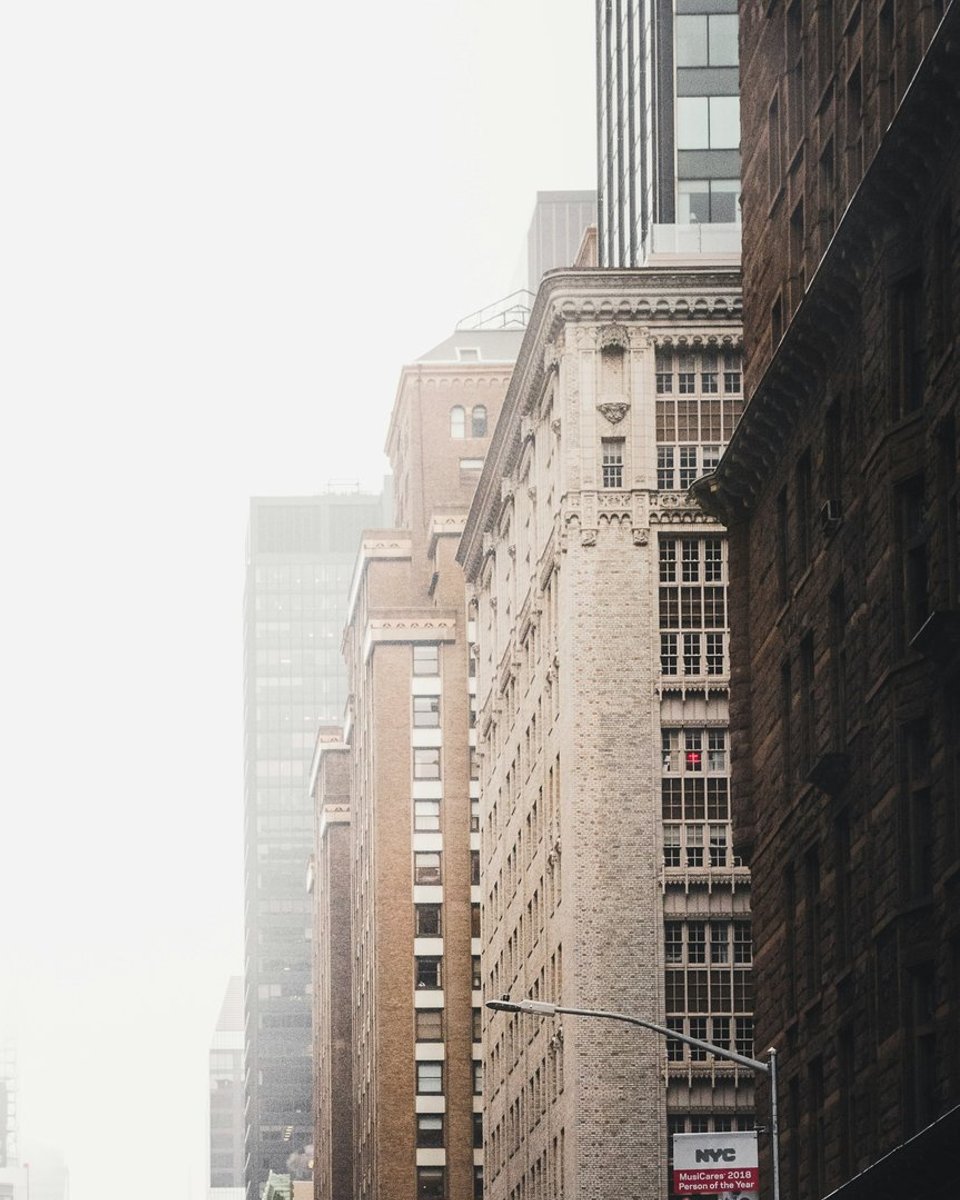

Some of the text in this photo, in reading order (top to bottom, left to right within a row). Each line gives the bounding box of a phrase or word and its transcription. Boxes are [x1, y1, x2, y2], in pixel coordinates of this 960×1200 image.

[695, 1148, 736, 1163] NYC
[679, 1171, 752, 1181] MusiCares 2018
[679, 1183, 708, 1191] Person
[720, 1181, 735, 1189] the
[736, 1181, 755, 1189] Year
